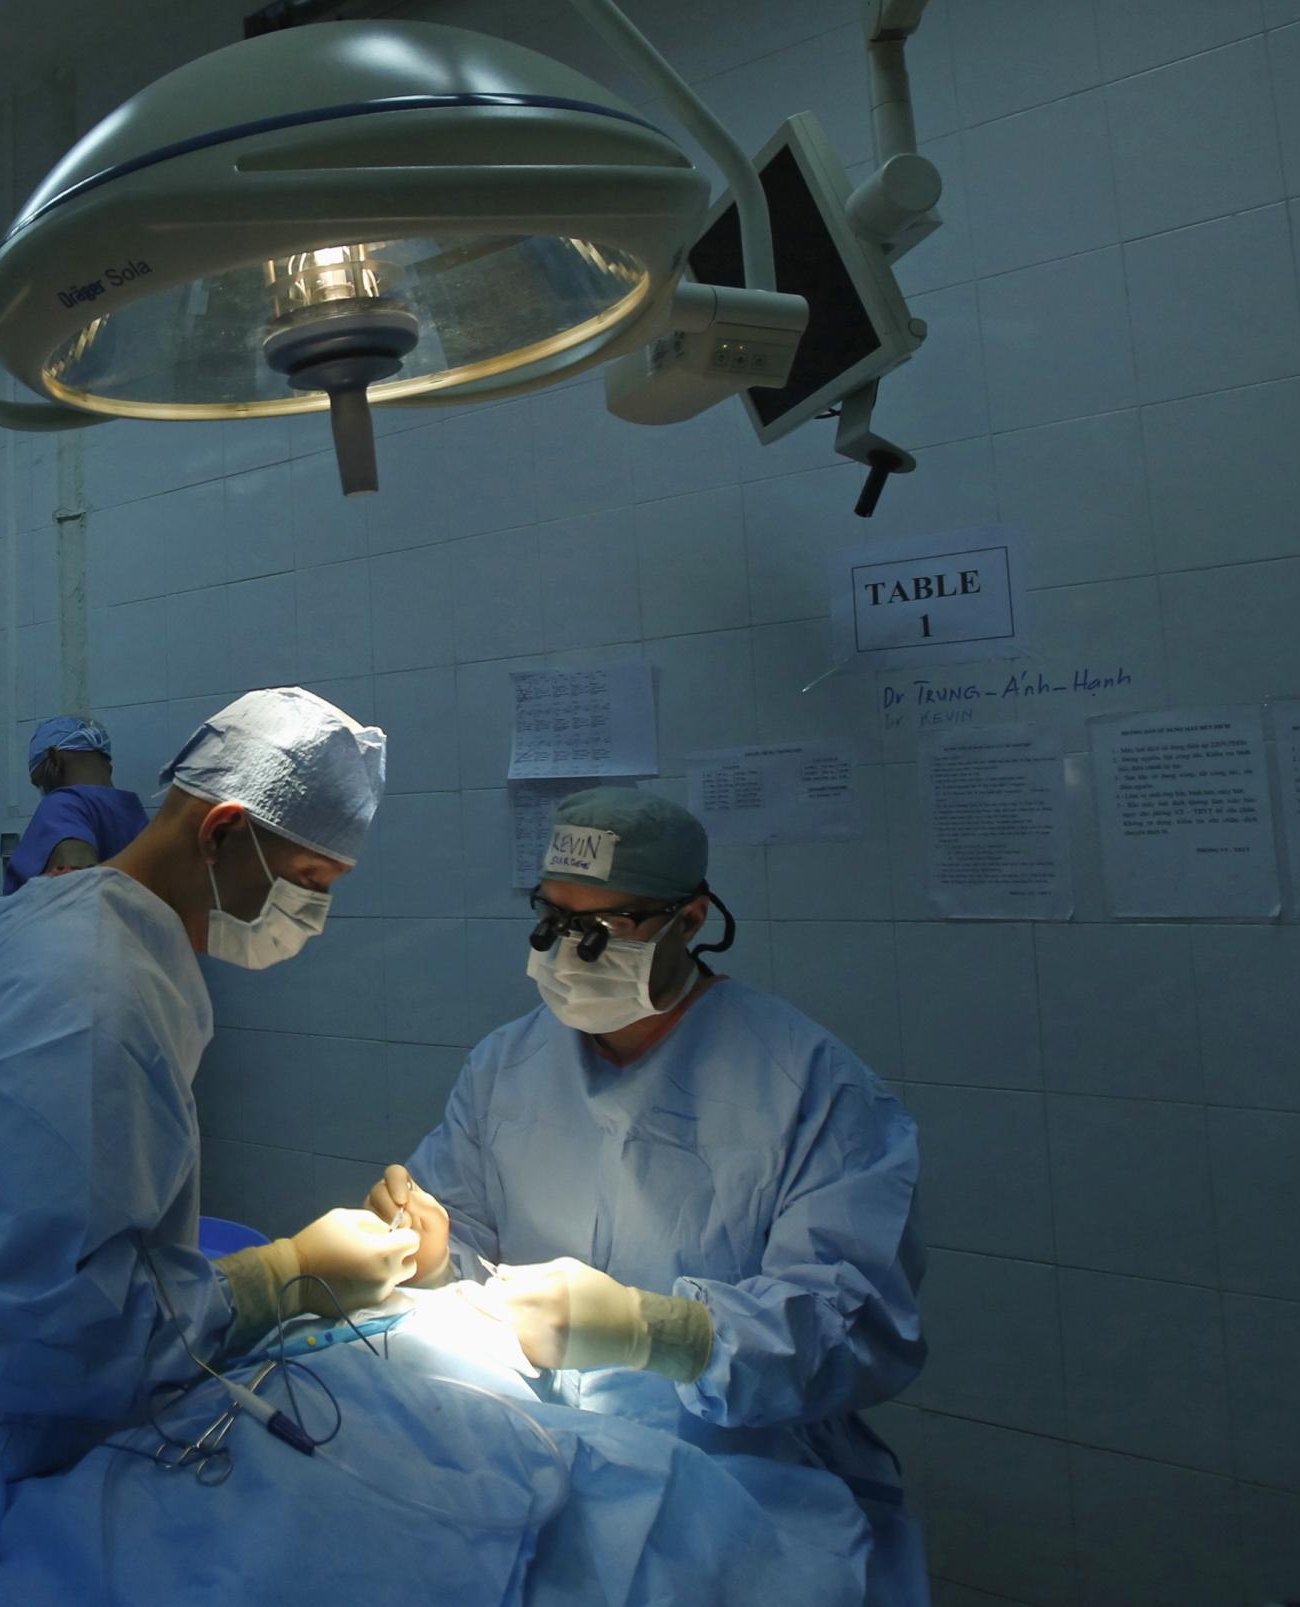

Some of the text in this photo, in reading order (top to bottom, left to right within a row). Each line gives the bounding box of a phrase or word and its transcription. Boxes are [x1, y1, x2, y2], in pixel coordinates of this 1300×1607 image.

[105, 260, 153, 286] Sola
[864, 569, 981, 606] TABLE
[917, 614, 933, 638] 1
[883, 685, 904, 709] Dr
